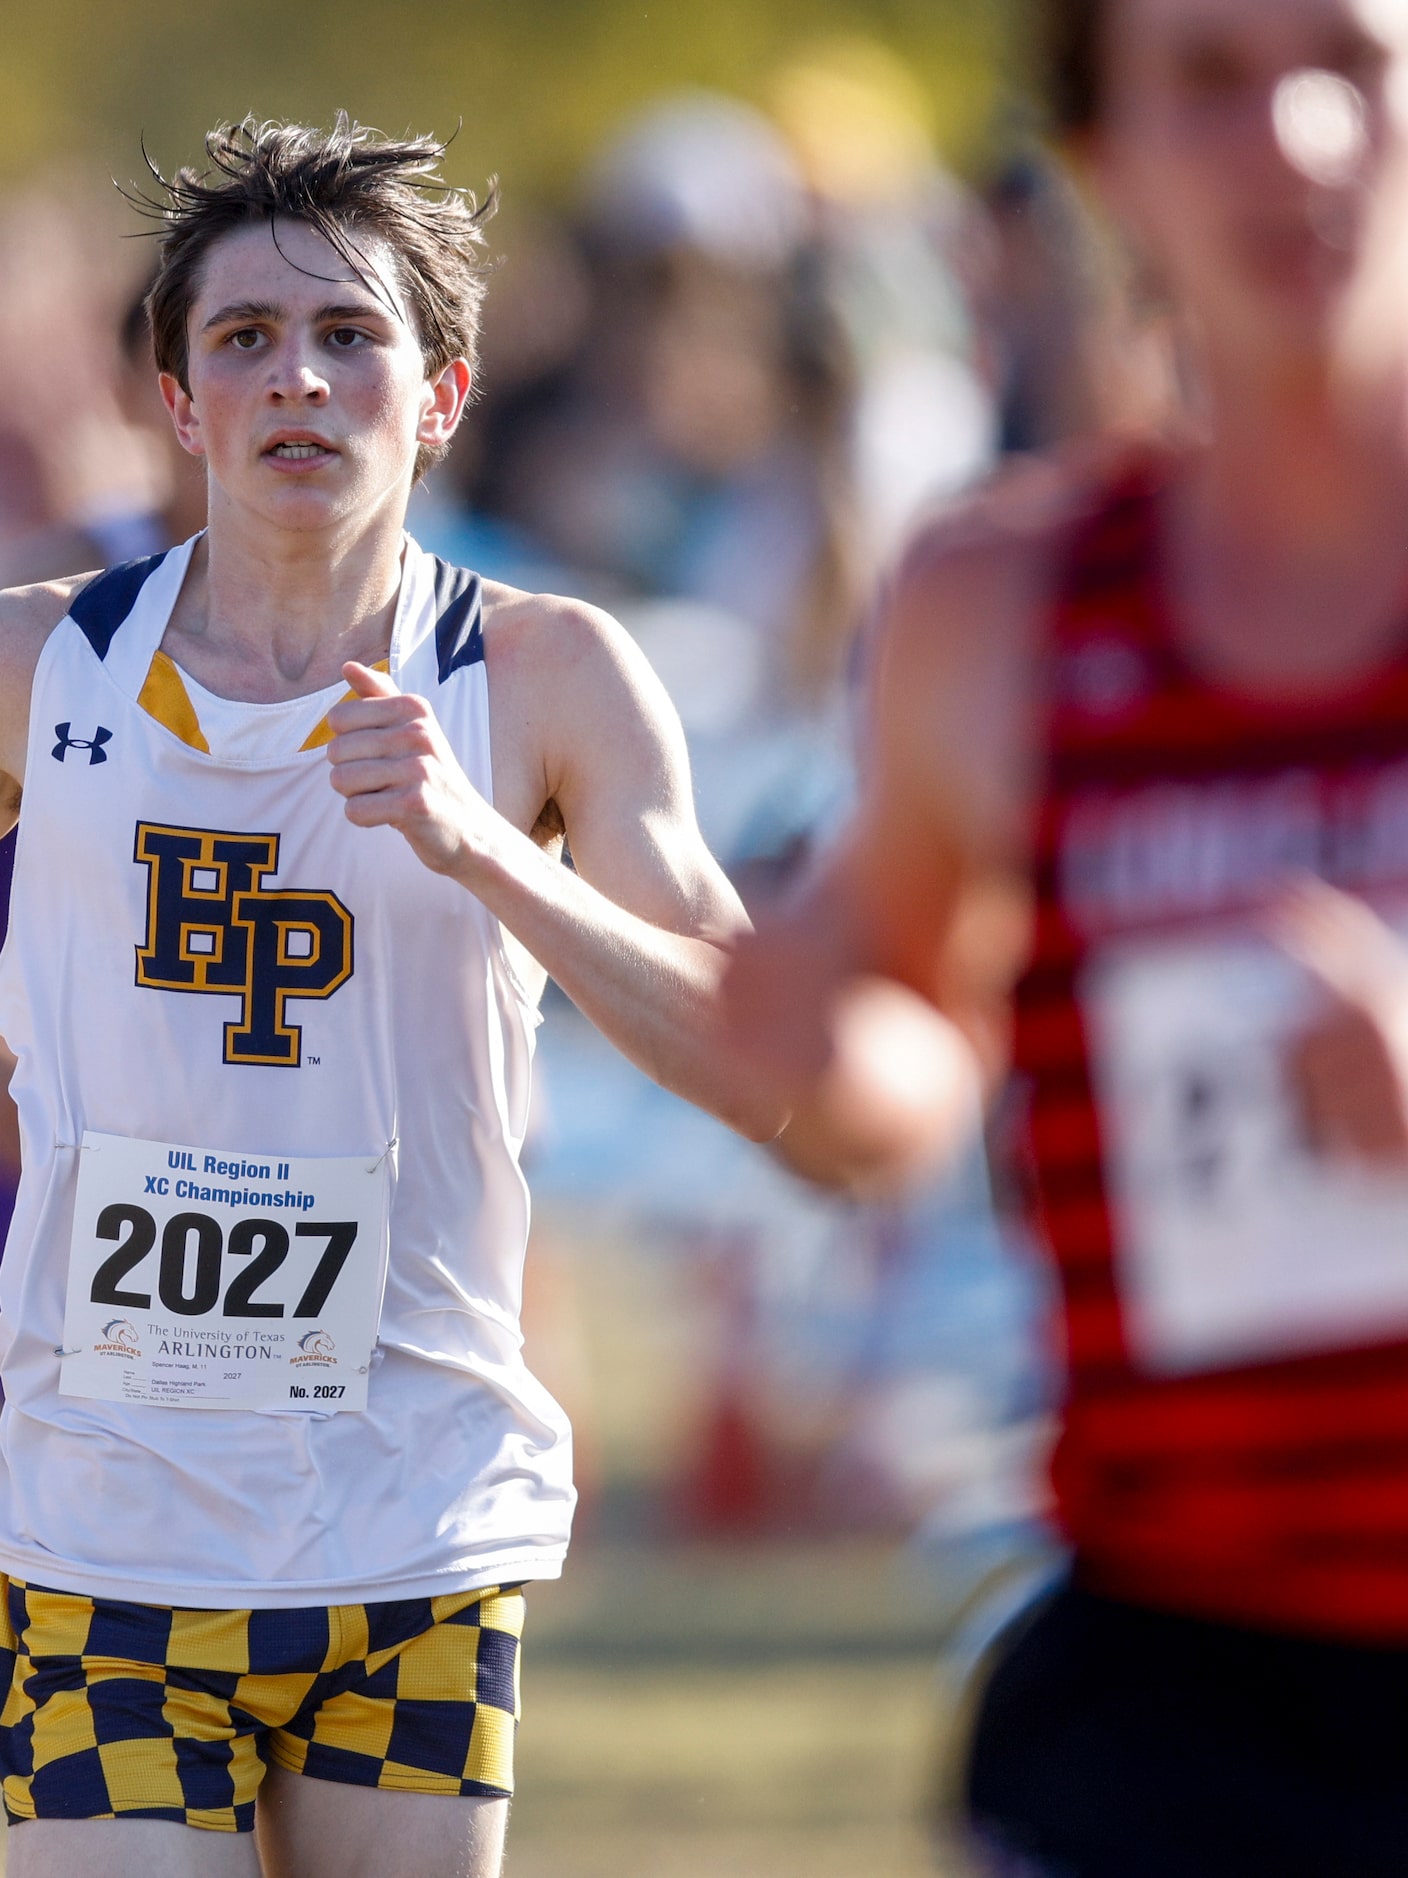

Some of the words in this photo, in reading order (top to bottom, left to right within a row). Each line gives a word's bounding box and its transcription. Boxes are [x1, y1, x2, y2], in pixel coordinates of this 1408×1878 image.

[133, 820, 355, 1068] HP
[307, 1055, 321, 1066] TM
[168, 1151, 197, 1172] UIL
[204, 1155, 270, 1181] Region
[278, 1162, 289, 1178] II
[144, 1176, 169, 1196] XC
[175, 1182, 315, 1211] Championship
[90, 1204, 358, 1318] 2027
[148, 1324, 169, 1337] The
[174, 1326, 231, 1342] University
[236, 1329, 250, 1342] of
[254, 1331, 285, 1342] Texas
[93, 1343, 142, 1358] MAVERICKS
[158, 1340, 272, 1359] ARLINGTON
[290, 1354, 338, 1365] MAVERICKS
[223, 1372, 242, 1380] 2027
[290, 1385, 309, 1398] No.
[313, 1385, 346, 1399] 2027
